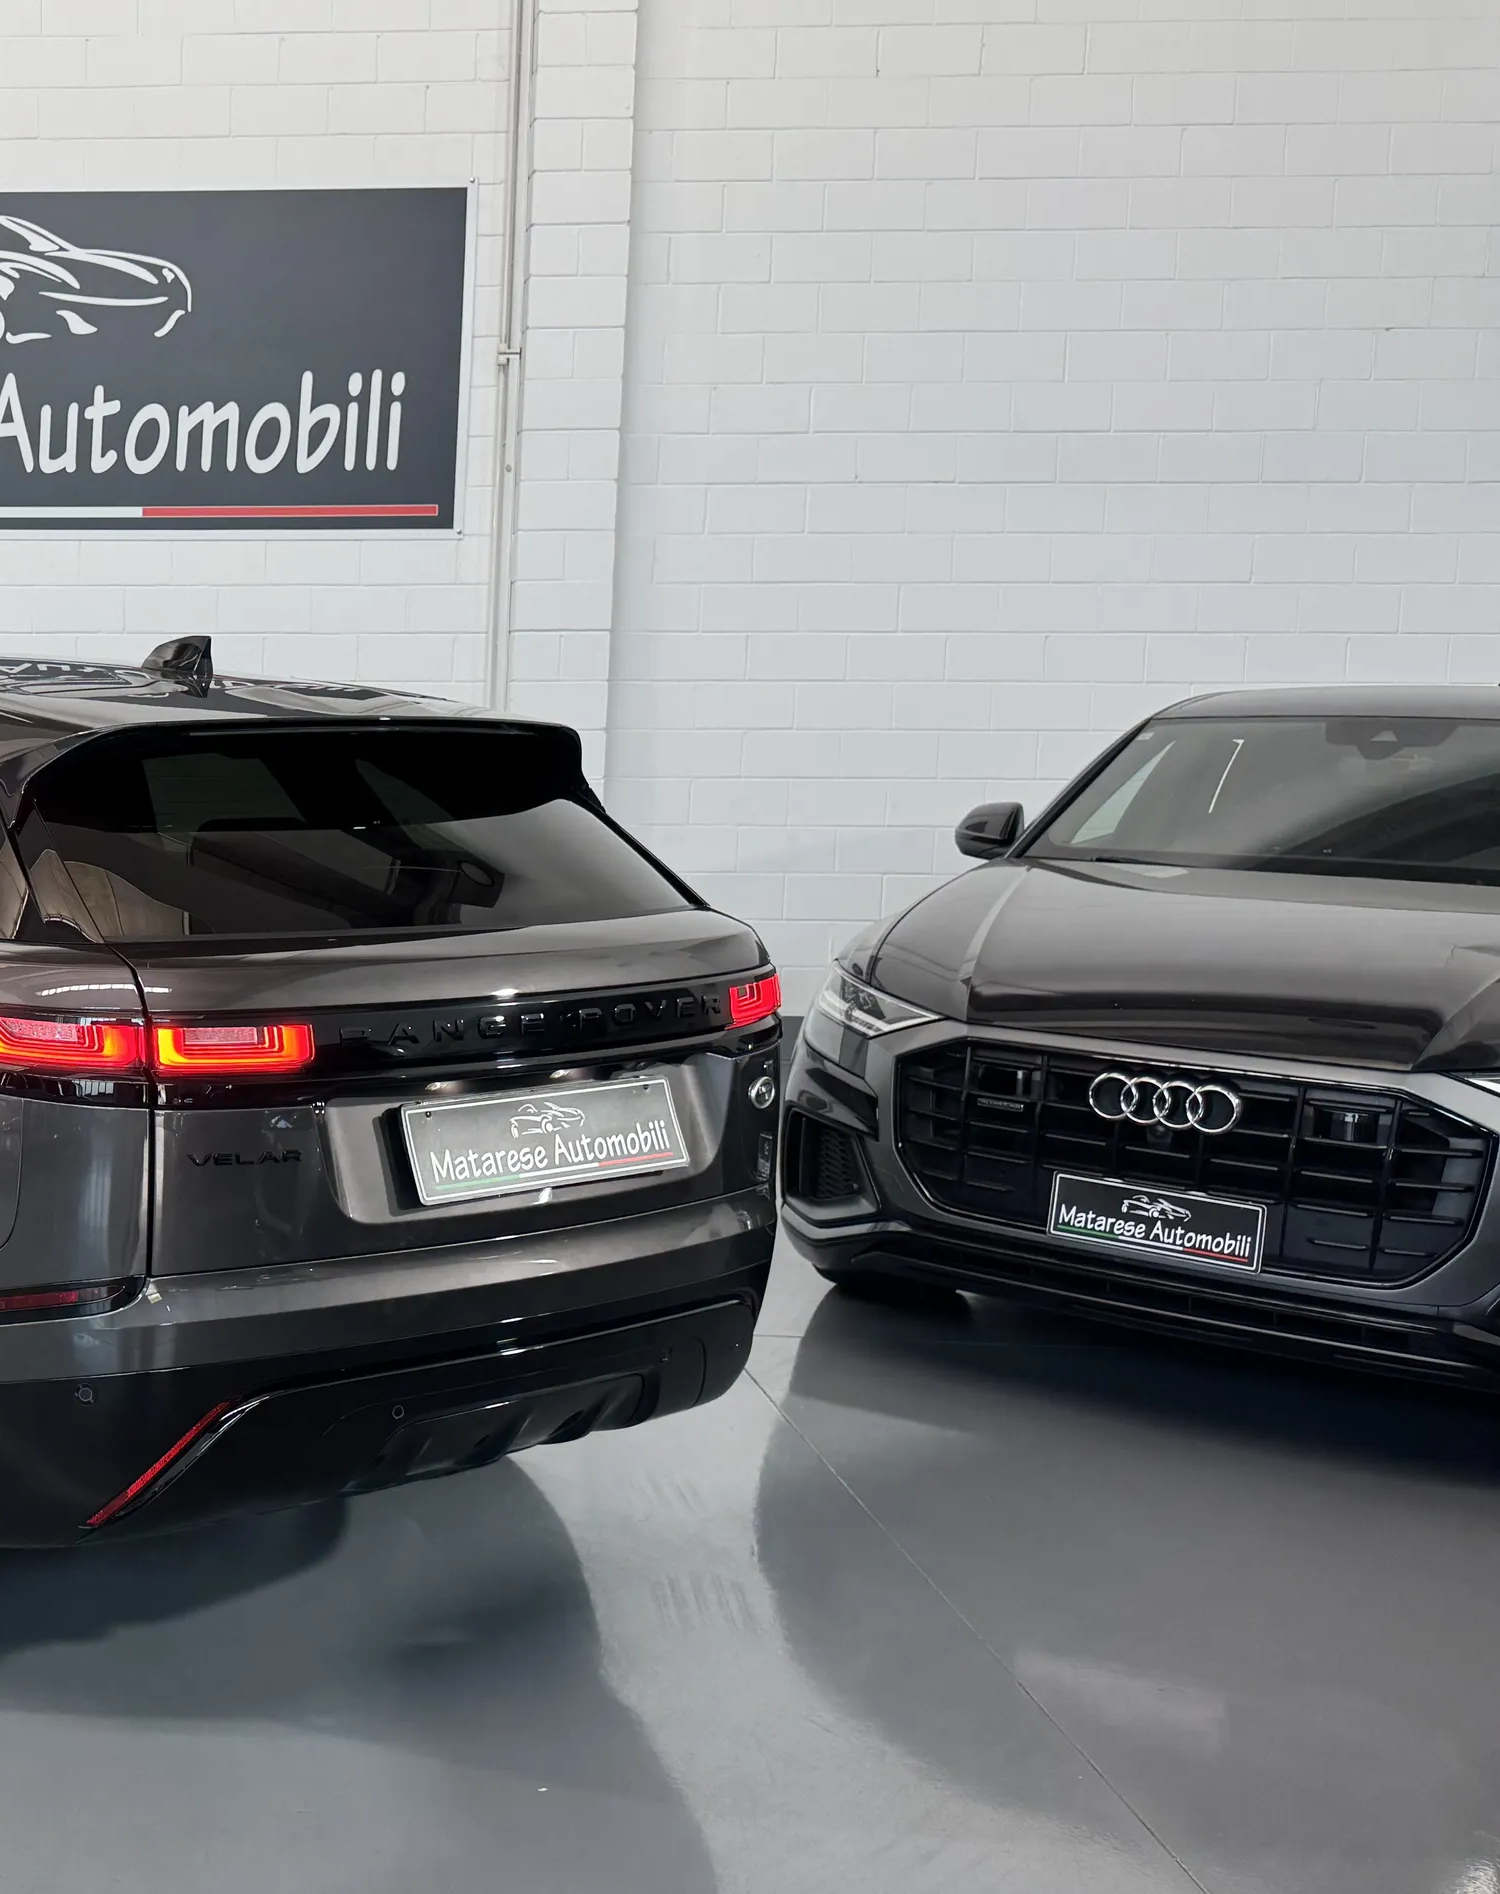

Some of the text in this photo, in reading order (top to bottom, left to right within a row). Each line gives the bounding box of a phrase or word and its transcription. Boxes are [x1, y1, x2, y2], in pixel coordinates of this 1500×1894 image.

[339, 993, 722, 1049] RANGE ROVER
[186, 1149, 303, 1167] VELAR
[429, 1119, 671, 1183] Matarese Automobili
[1058, 1203, 1252, 1258] Matarese Automobili
